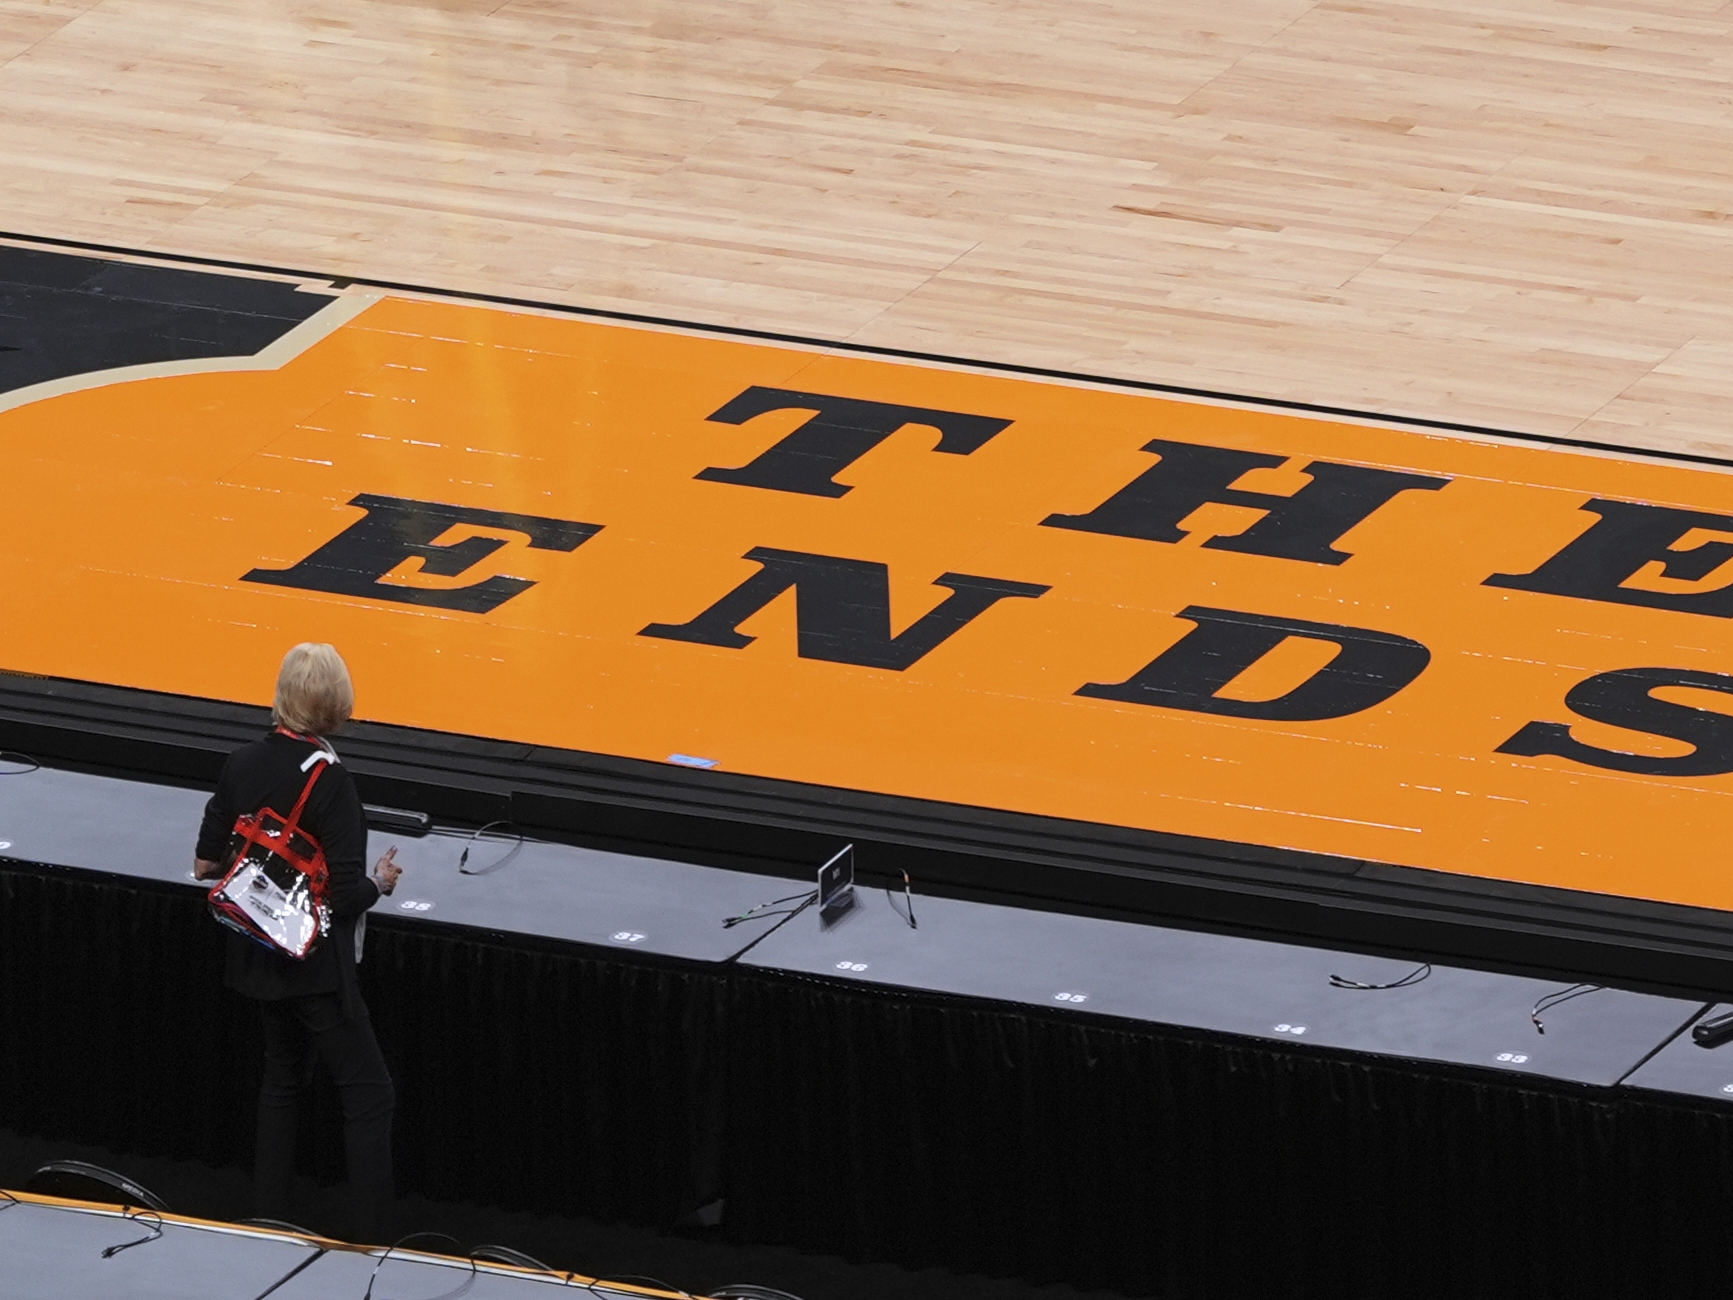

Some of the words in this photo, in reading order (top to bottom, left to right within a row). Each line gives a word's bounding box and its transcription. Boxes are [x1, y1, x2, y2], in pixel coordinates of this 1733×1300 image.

[614, 932, 644, 941] 37
[836, 961, 867, 971] 36
[1055, 993, 1086, 1002] 35
[1275, 1024, 1306, 1034] 34
[1497, 1053, 1527, 1063] 33
